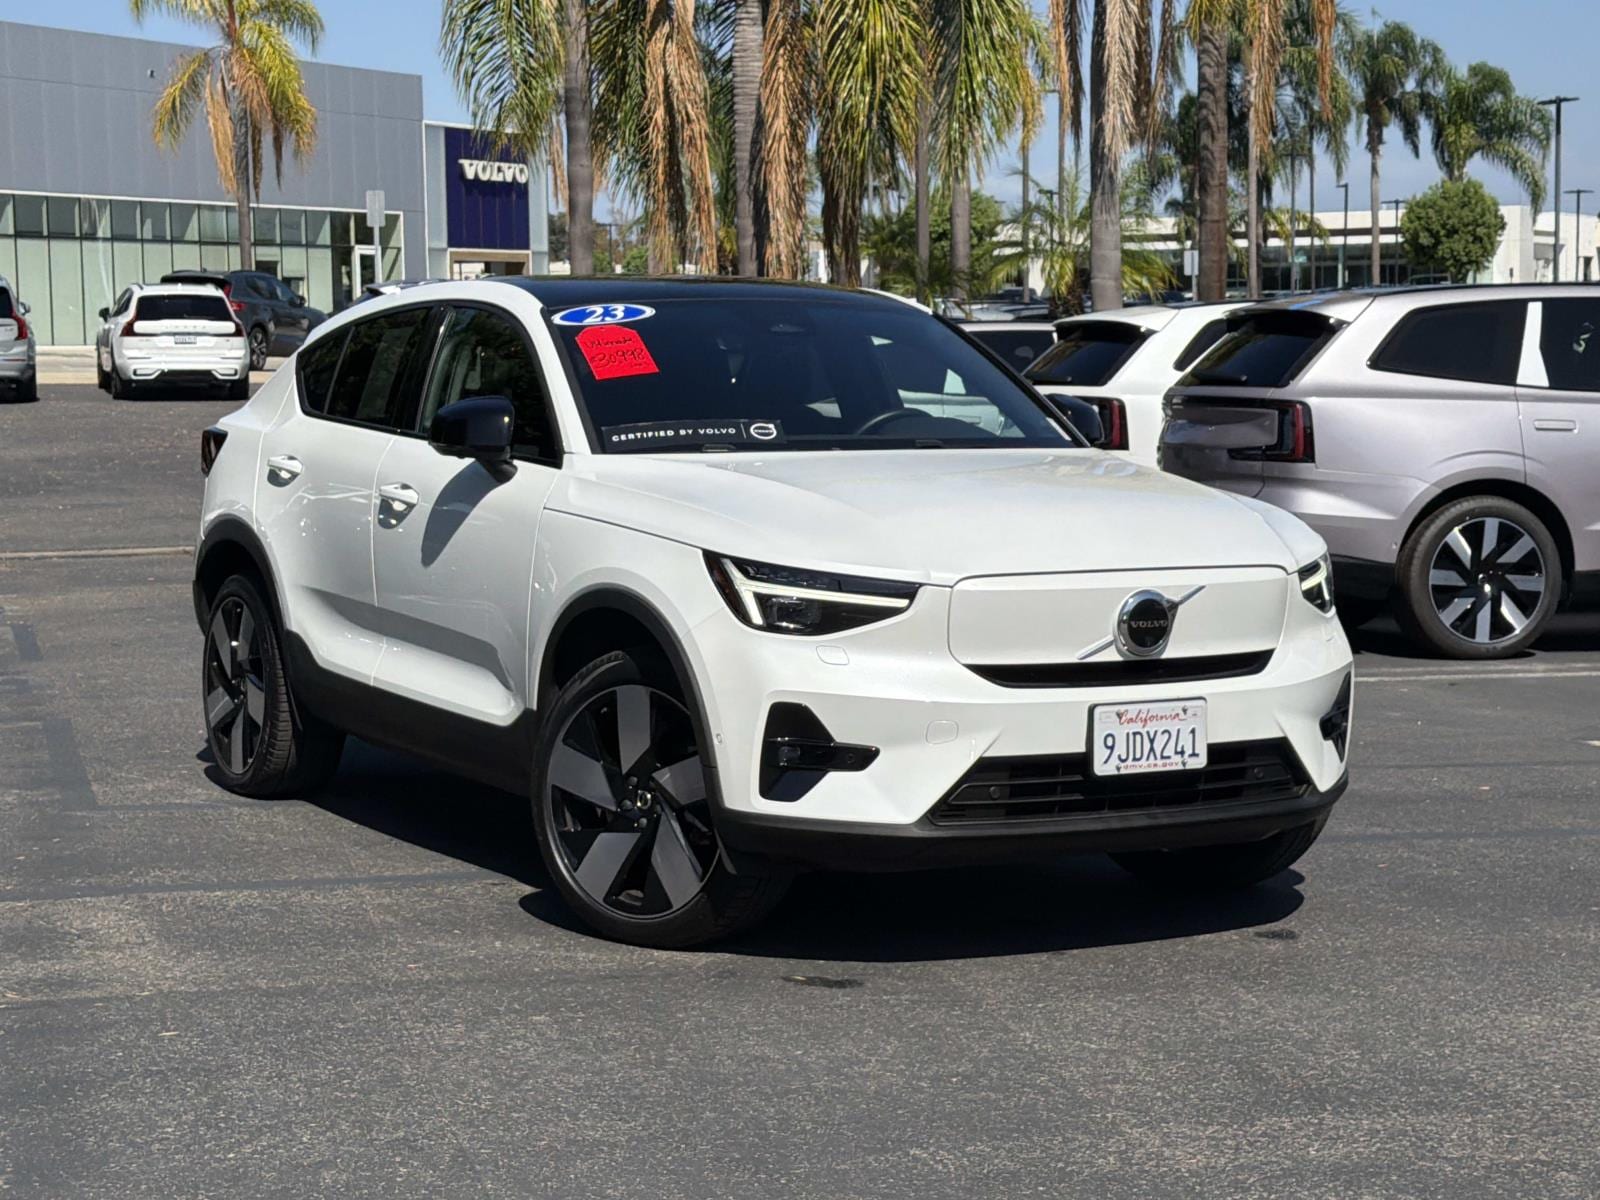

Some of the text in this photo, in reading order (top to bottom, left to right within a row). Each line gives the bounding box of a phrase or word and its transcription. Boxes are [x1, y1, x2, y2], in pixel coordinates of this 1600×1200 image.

[457, 159, 529, 184] VOLVO
[581, 306, 626, 323] 23
[611, 427, 736, 442] CERTIFIED BY VOLVO
[1130, 619, 1168, 629] VOLVO
[1118, 707, 1188, 728] California
[1102, 726, 1200, 766] 9JDX241
